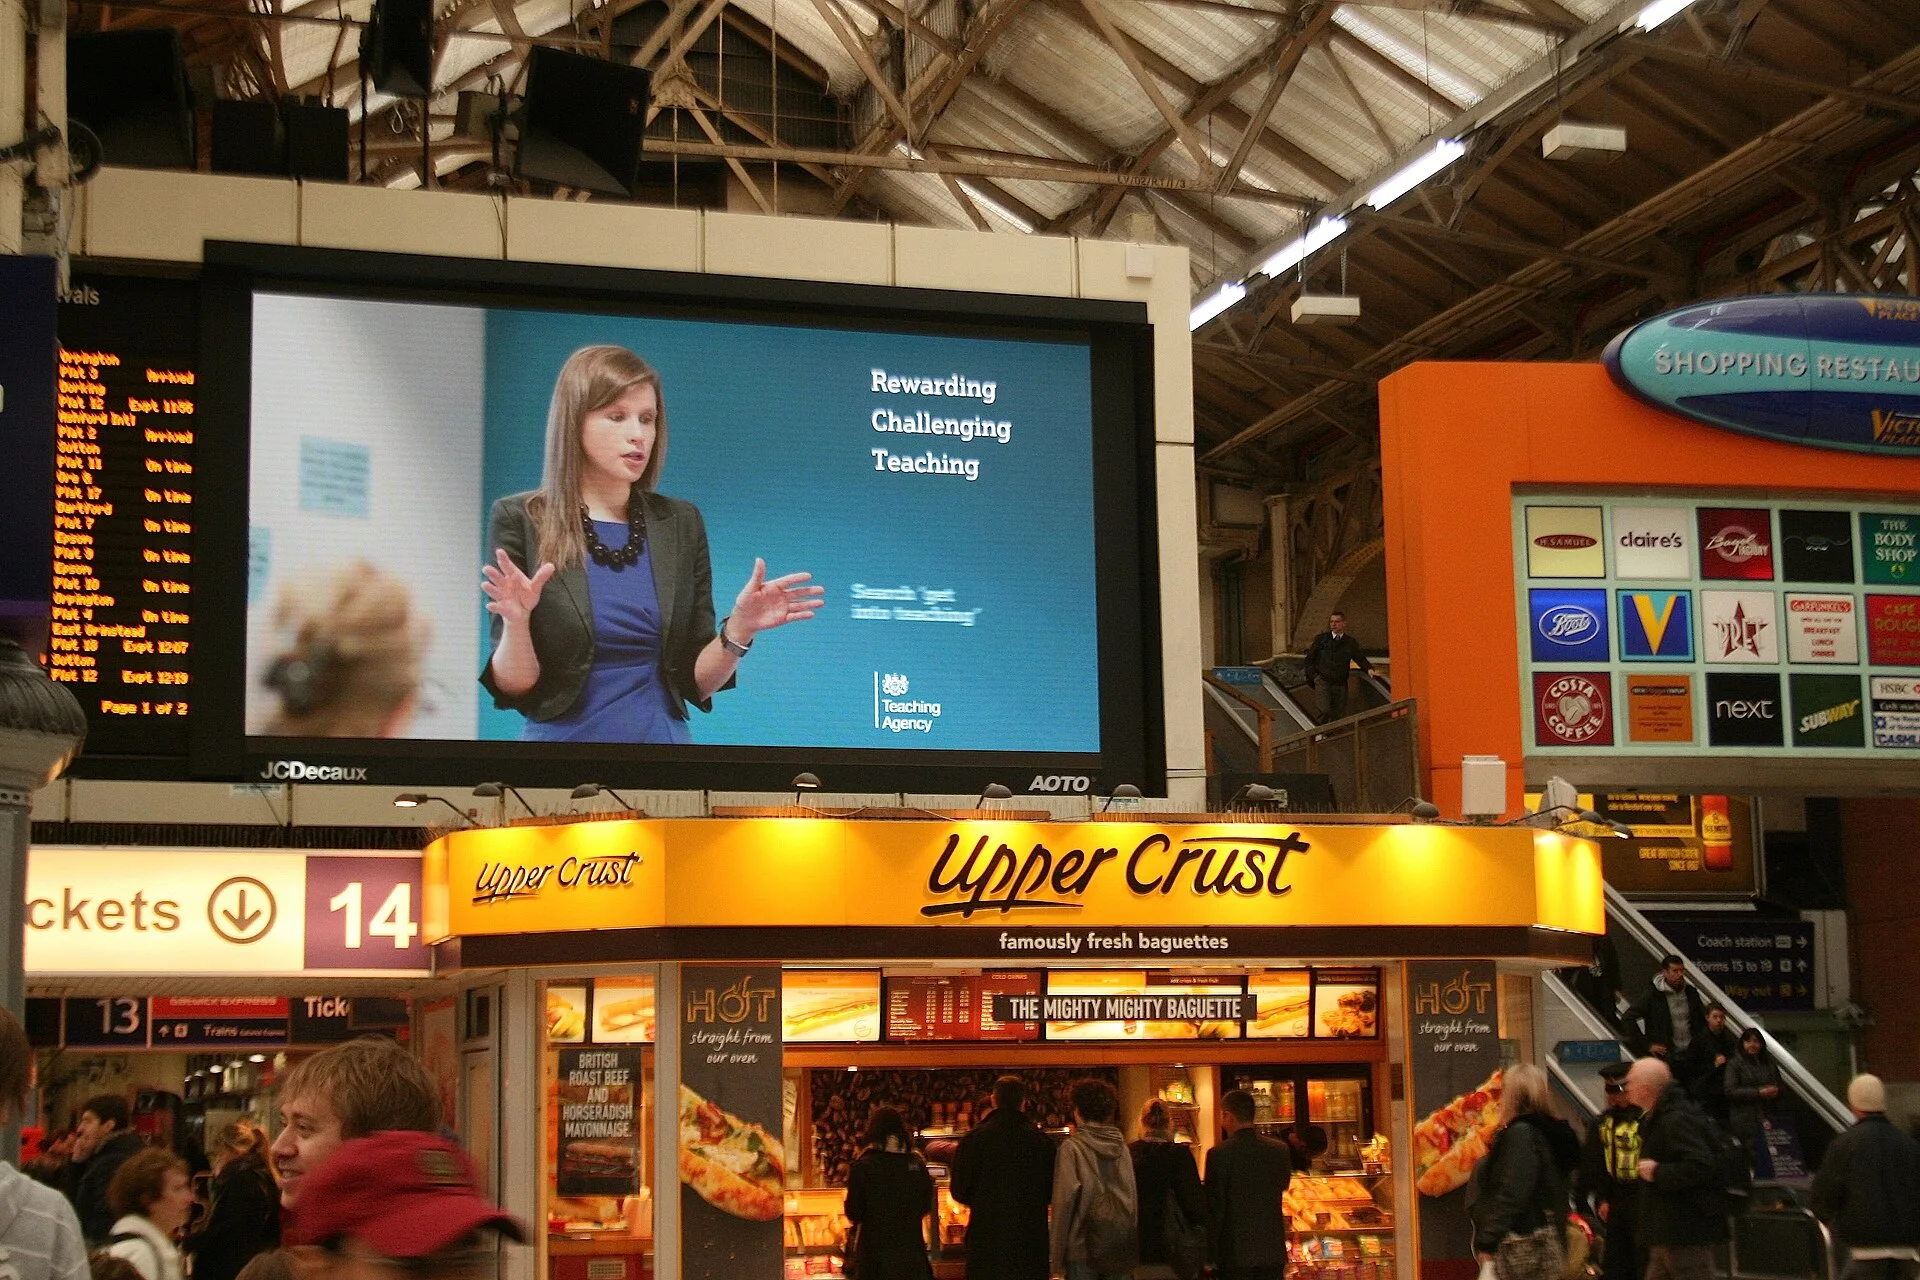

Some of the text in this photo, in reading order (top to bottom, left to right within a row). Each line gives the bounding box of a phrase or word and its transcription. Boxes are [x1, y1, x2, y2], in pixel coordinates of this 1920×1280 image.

[60, 284, 100, 306] vals
[58, 350, 121, 366] Orpington
[1655, 350, 1807, 377] SHOPPING
[58, 364, 86, 380] Plat
[146, 368, 195, 384] Arrived
[58, 379, 106, 396] Dorking
[870, 369, 997, 404] Rewarding
[57, 394, 85, 409] Plat
[57, 410, 108, 425] Ashford
[871, 408, 1012, 443] Challenging
[57, 424, 84, 439] Plat
[145, 428, 193, 444] Arrived
[57, 439, 100, 454] Sutton
[56, 454, 83, 469] Plat
[145, 458, 192, 473] On time
[871, 448, 980, 481] Teaching
[55, 484, 83, 499] Plat
[144, 488, 192, 503] On time
[55, 500, 113, 515] Dartford
[54, 515, 82, 529] Plat
[143, 518, 191, 533] On time
[1881, 519, 1908, 531] THE
[1619, 531, 1683, 549] claire's
[1873, 532, 1917, 547] BODY
[54, 545, 82, 559] Plat
[143, 549, 190, 563] On time
[1875, 549, 1918, 563] SHOP
[53, 576, 80, 590] Plat
[142, 579, 190, 593] On time
[52, 591, 115, 606] Orpington
[52, 606, 80, 620] Plat
[142, 609, 189, 624] On time
[52, 622, 146, 638] East Grinstead
[1548, 612, 1592, 636] Boots
[1716, 619, 1764, 651] PRET
[51, 637, 80, 651] Plat
[122, 638, 154, 654] Expt
[51, 653, 96, 666] Sutton
[50, 667, 98, 682] Plat 12
[121, 670, 154, 684] Expt
[1550, 678, 1594, 698] COSTA
[1880, 683, 1909, 694] HSBC
[101, 700, 188, 715] Page 1 of 2
[881, 699, 941, 716] Teaching
[1716, 700, 1775, 719] next
[882, 715, 933, 732] Agency
[1799, 699, 1860, 734] SUBWAY
[1548, 715, 1602, 740] COFFEE
[260, 761, 367, 780] JCDecaux
[1028, 775, 1090, 792] AOTO
[472, 851, 643, 904] Upper Crust
[920, 832, 1310, 918] Upper Crust
[26, 882, 418, 950] ckets 14
[999, 932, 1229, 954] famously fresh baguettes
[1698, 935, 1773, 948] Coach station
[1732, 959, 1744, 972] 15
[1746, 960, 1757, 972] to
[687, 977, 775, 1023] HOT
[1416, 971, 1491, 1015] HOT
[303, 996, 347, 1018] Tick
[1010, 998, 1039, 1019] THE
[1044, 998, 1102, 1019] MIGHTY
[1105, 998, 1164, 1019] MIGHTY
[1167, 998, 1242, 1019] BAGUETTE
[97, 998, 140, 1035] 13
[203, 1023, 239, 1036] Trains
[1418, 1018, 1492, 1041] straight from
[689, 1028, 774, 1051] straight from
[1434, 1042, 1480, 1052] our oven
[579, 1053, 618, 1069] BRITISH
[706, 1053, 758, 1064] our oven
[569, 1070, 629, 1086] ROAST BEEF
[587, 1087, 609, 1103] AND
[563, 1104, 633, 1120] HORSERADISH
[565, 1122, 632, 1138] MAYONNAISE.
